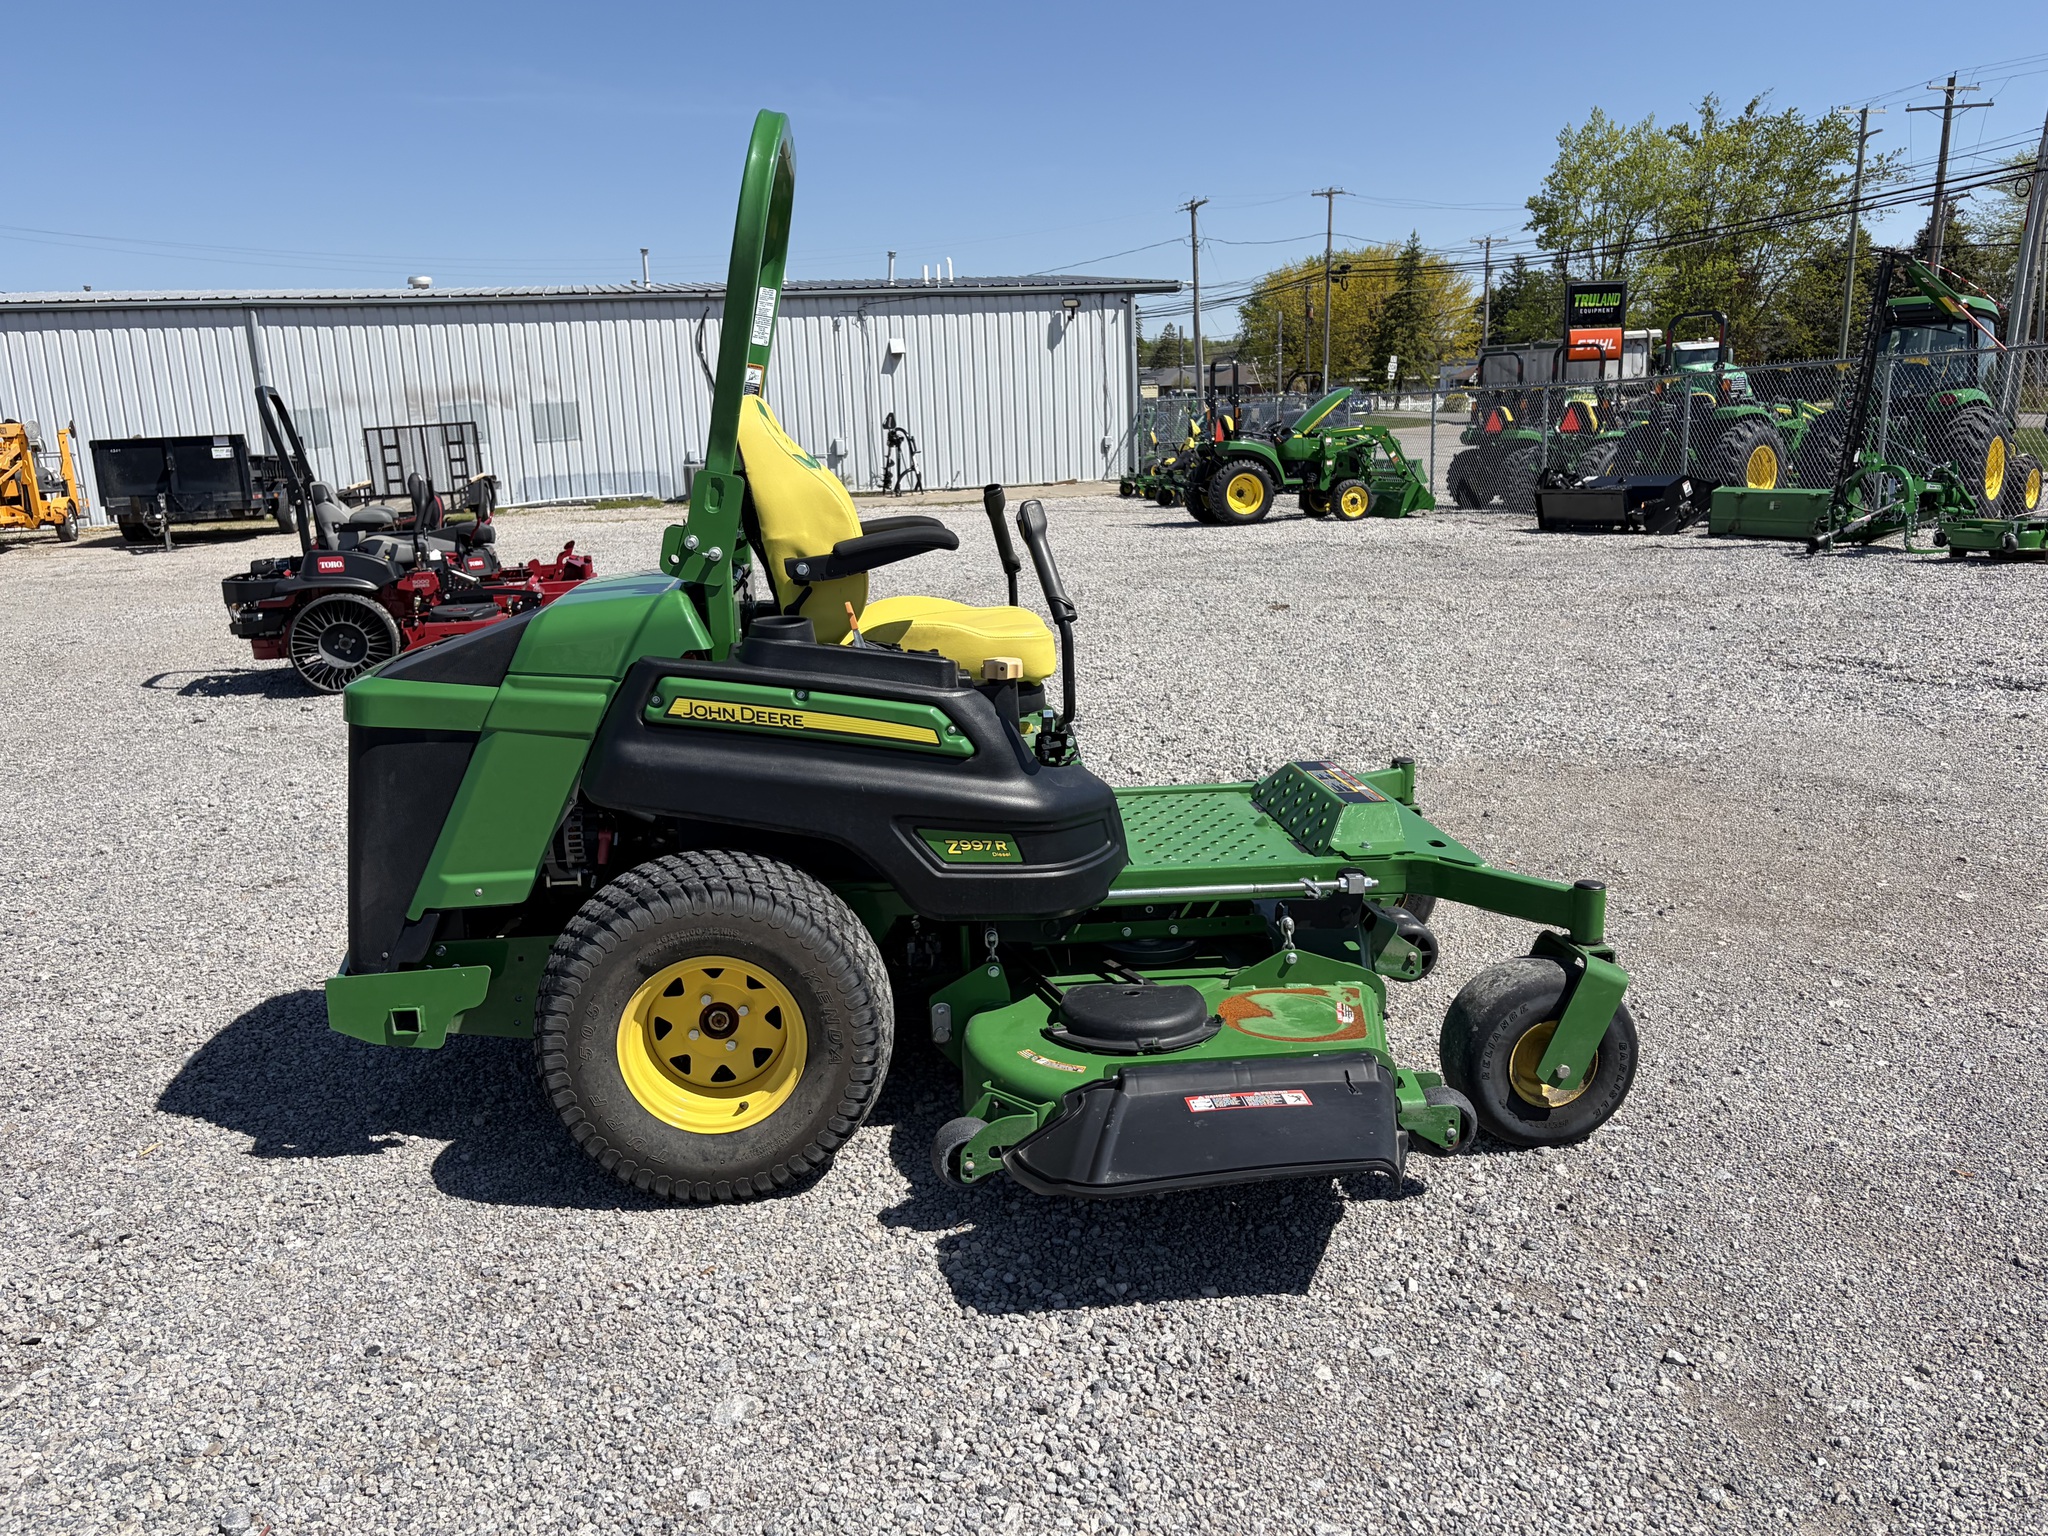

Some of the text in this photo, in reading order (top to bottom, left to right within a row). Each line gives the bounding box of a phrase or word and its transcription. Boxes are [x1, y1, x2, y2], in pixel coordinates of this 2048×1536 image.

[1574, 293, 1621, 307] TRULAND
[1575, 338, 1616, 351] STIHL
[320, 560, 343, 568] TORO
[683, 702, 804, 727] JOHN DEERE
[944, 839, 1008, 854] Z997R
[801, 967, 844, 1065] KENDA
[579, 1001, 669, 1165] TURF 505
